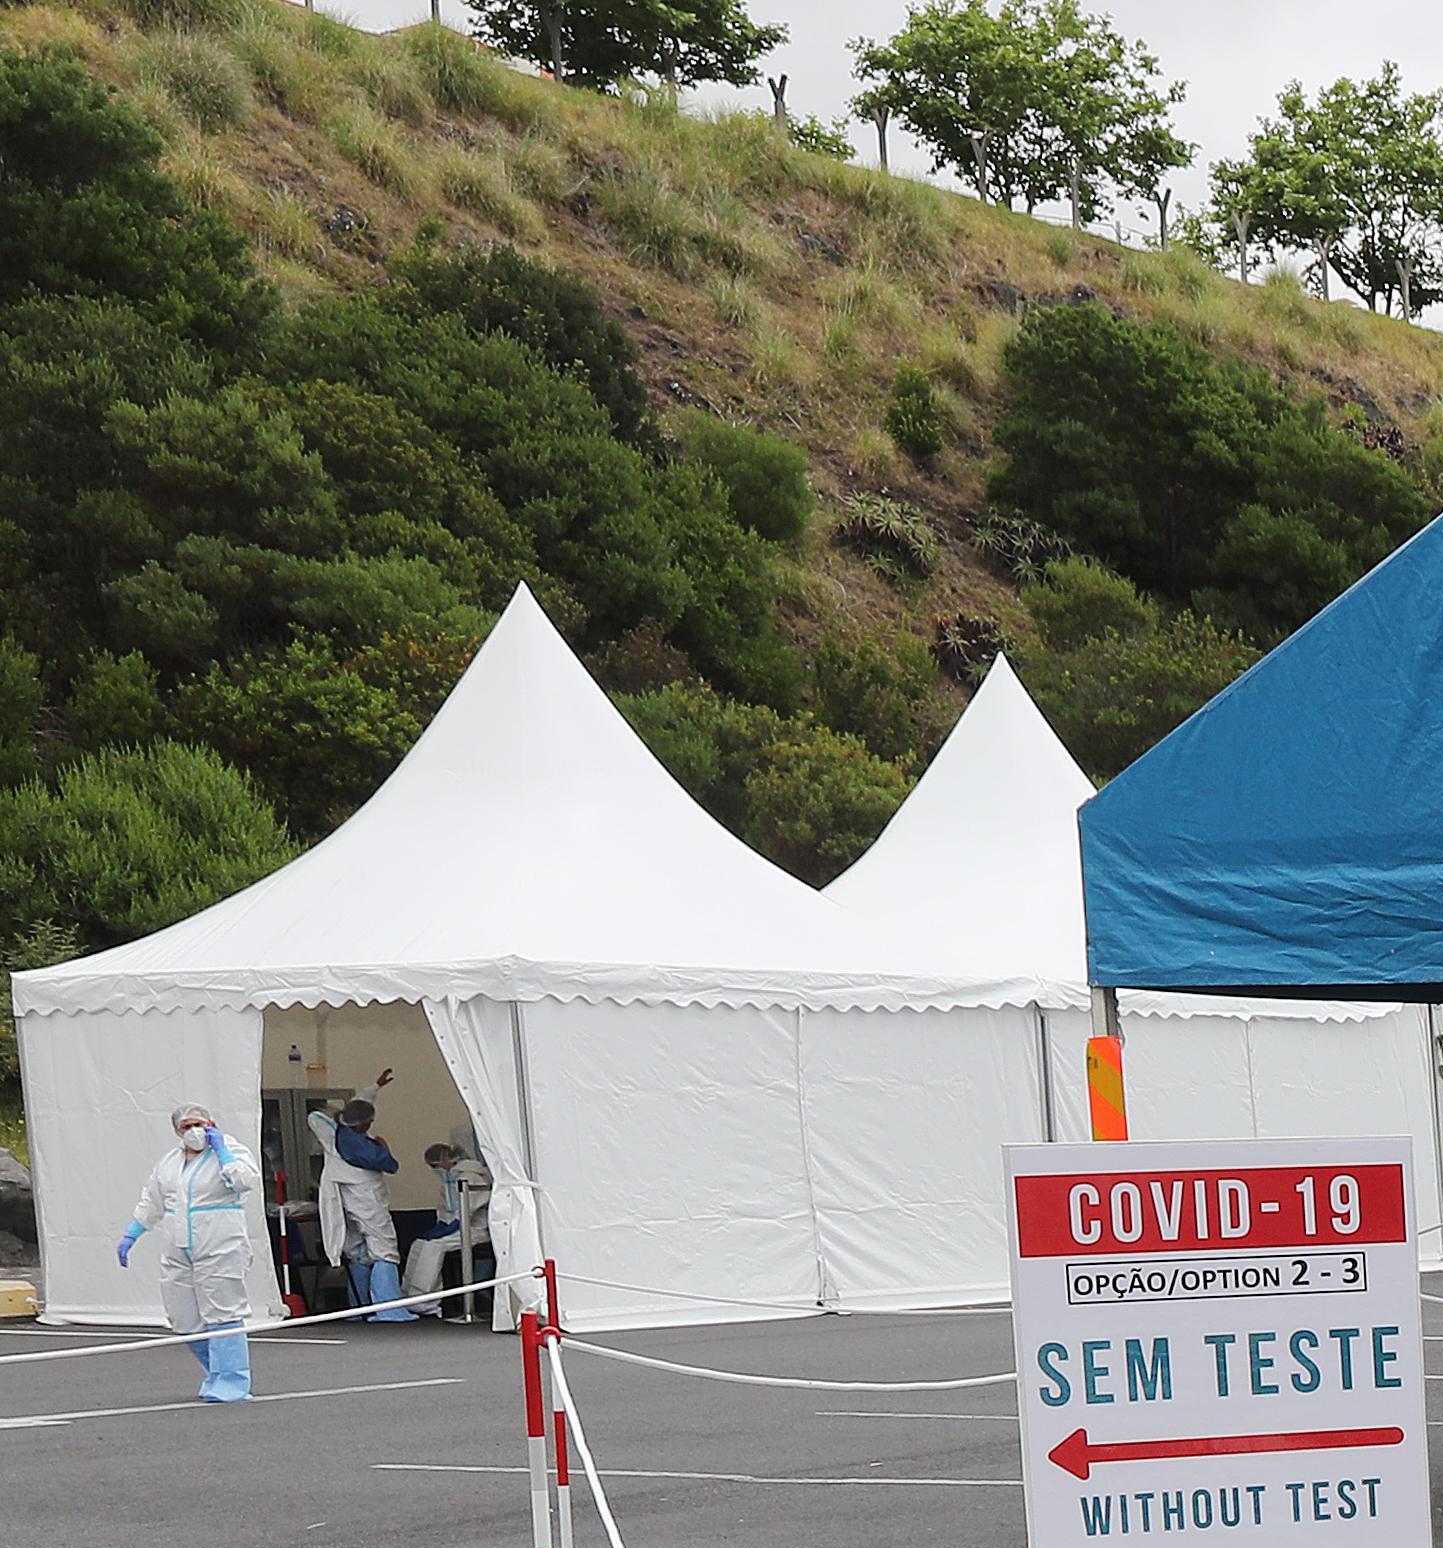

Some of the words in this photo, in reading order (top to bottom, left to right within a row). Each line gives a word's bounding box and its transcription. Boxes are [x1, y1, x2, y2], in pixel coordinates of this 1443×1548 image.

[1069, 1174, 1361, 1245] COVID-19
[1073, 1266, 1281, 1298] OPÇÃO/OPTION
[1290, 1260, 1311, 1286] 2
[1342, 1257, 1361, 1285] 3
[1037, 1337, 1172, 1407] SEM
[1204, 1326, 1401, 1398] TESTE
[1080, 1485, 1266, 1537] WITHOUT
[1285, 1478, 1382, 1523] TEST
